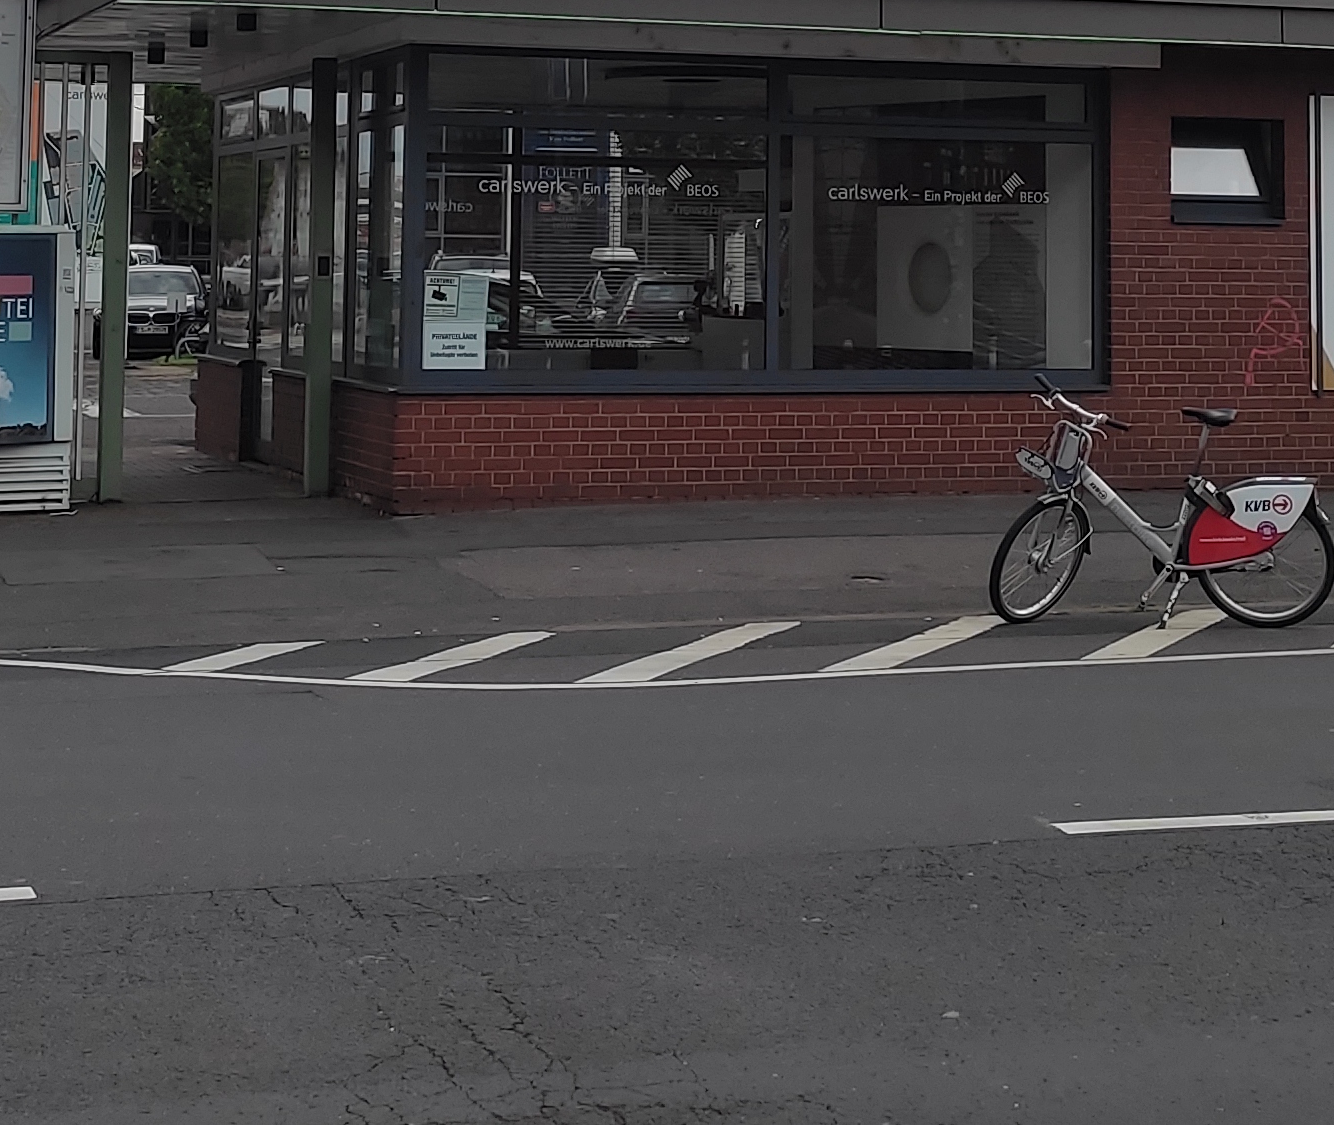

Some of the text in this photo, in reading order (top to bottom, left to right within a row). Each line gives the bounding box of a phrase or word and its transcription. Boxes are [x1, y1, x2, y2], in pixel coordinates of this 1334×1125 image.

[582, 182, 602, 196] Ein
[647, 184, 668, 196] der
[686, 184, 719, 197] BEOS
[827, 183, 910, 201] carlswerk
[923, 190, 941, 202] Ein
[943, 190, 983, 205] Projekt
[984, 191, 1003, 203] der
[1019, 191, 1050, 204] BEOS
[1, 297, 33, 319] TEI
[1244, 499, 1271, 513] KVB
